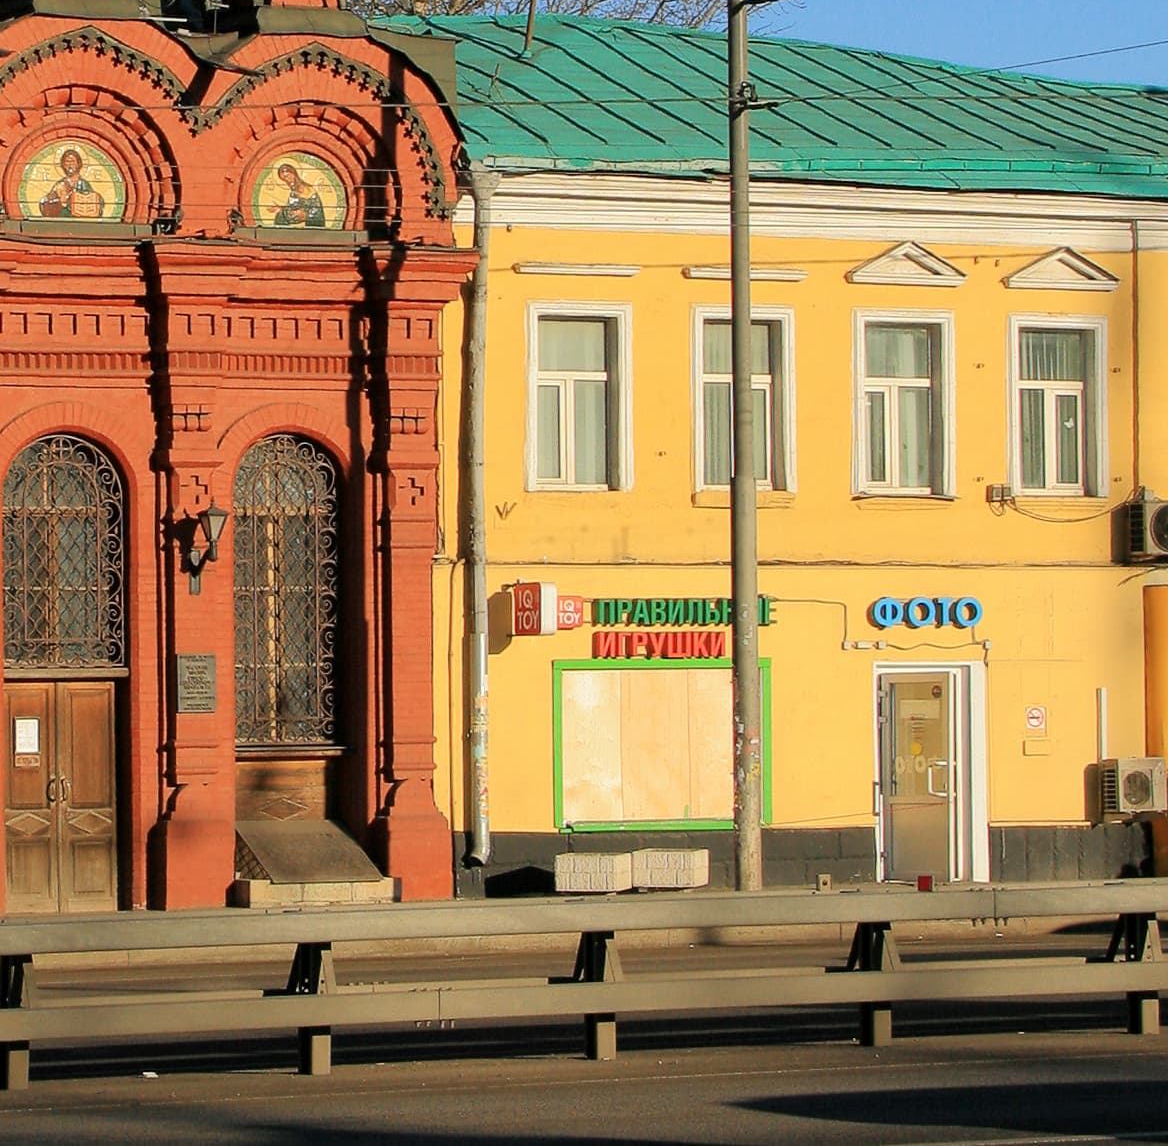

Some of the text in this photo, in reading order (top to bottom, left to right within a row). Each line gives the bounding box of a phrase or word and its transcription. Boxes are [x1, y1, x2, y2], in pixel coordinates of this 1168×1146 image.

[518, 589, 534, 610] IQ
[559, 598, 576, 612] IQ
[517, 610, 540, 631] TOY
[558, 612, 582, 626] TOY
[872, 596, 984, 627] ФОТО
[597, 630, 726, 658] ИГРУШКИ
